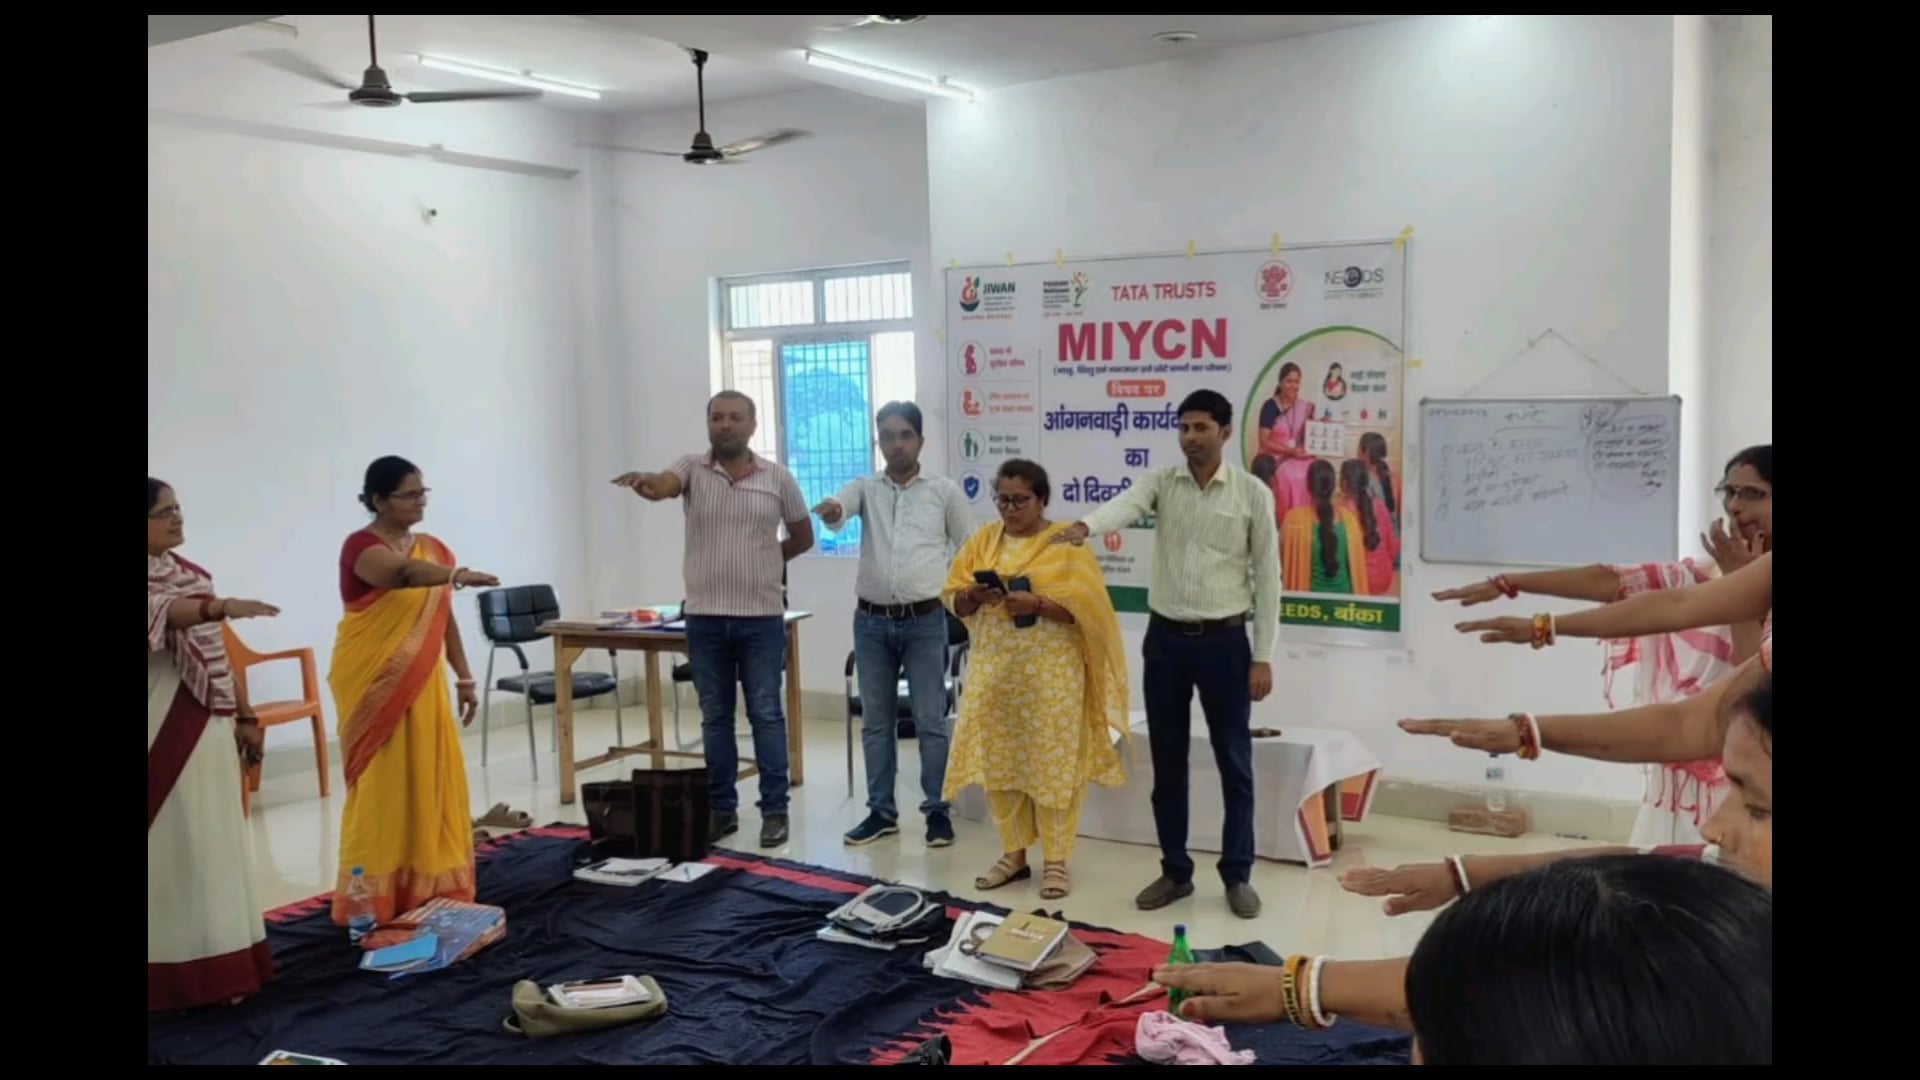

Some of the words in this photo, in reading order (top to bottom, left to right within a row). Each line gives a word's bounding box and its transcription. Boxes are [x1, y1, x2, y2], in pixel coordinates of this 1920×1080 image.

[983, 281, 1016, 295] JIWAN
[1112, 284, 1149, 301] TATA
[1153, 281, 1217, 300] TRUSTS
[1058, 317, 1228, 362] MIYCN
[1143, 383, 1161, 397] पर
[1043, 403, 1129, 438] आंगनवाड़ी
[1124, 448, 1150, 468] का
[1062, 477, 1081, 503] दो
[1332, 602, 1385, 624] बांका
